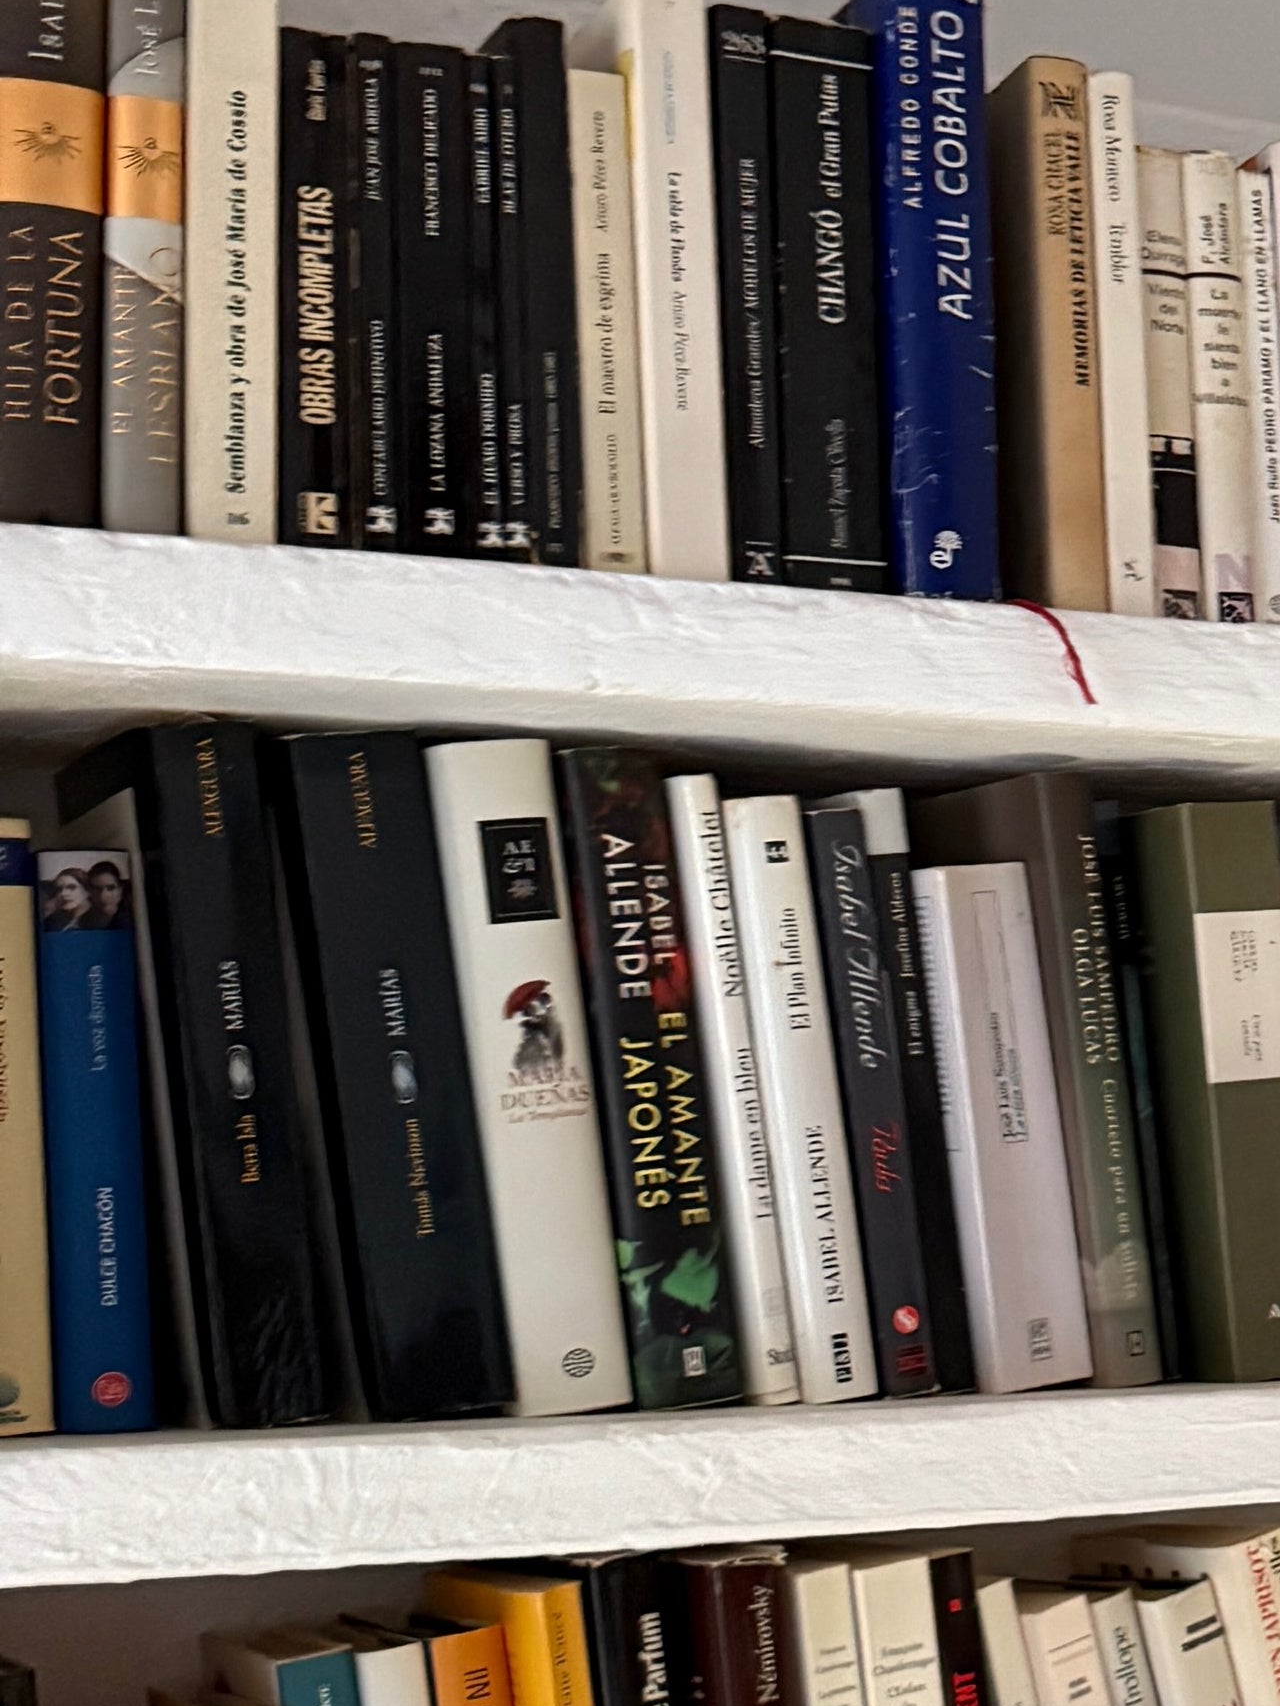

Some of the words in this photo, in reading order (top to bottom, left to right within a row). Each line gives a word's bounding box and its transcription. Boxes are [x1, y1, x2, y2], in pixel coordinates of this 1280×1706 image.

[900, 6, 920, 82] CONDE
[225, 90, 248, 150] Cossío
[819, 75, 839, 126] Putas
[929, 10, 969, 193] COBALTO
[1103, 94, 1120, 131] Rosa
[226, 157, 247, 179] de
[820, 131, 840, 176] Gran
[903, 100, 923, 208] ALFREDO
[1065, 130, 1082, 184] VALLE
[1105, 136, 1125, 202] Montero
[224, 185, 247, 241] María
[823, 182, 842, 198] el
[1047, 195, 1066, 236] ROSA
[1251, 189, 1265, 242] LLAMAS
[7, 224, 35, 262] LA
[1067, 189, 1086, 256] LETICIA
[224, 247, 251, 289] José
[297, 186, 334, 341] INCOMPLETAS
[594, 253, 617, 311] esgrima
[810, 210, 845, 323] CHANGÓ
[936, 213, 973, 318] AZUL
[1069, 260, 1087, 282] DE
[1255, 247, 1268, 265] EN
[5, 284, 33, 321] DE
[226, 295, 248, 318] de
[1256, 269, 1272, 313] LLANO
[43, 231, 84, 425] FORTUNA
[226, 325, 248, 366] obra
[595, 316, 615, 333] de
[1070, 289, 1091, 387] MEMORIAS
[1259, 317, 1272, 332] EL
[3, 343, 34, 421] HIJA
[230, 374, 251, 385] y
[299, 348, 336, 424] OBRAS
[597, 338, 616, 396] maestro
[600, 400, 616, 414] El
[1264, 408, 1279, 452] PEDRO
[224, 392, 247, 492] Semblanza
[196, 738, 225, 836] ALFAGUARA
[349, 751, 377, 848] ALFAGUARA
[699, 809, 731, 912] Châtelet
[601, 834, 649, 998] ALLENDE
[642, 865, 676, 963] ISABEL
[831, 843, 864, 939] Isabel
[713, 918, 743, 998] Noëlle
[777, 908, 804, 966] Infinito
[216, 960, 244, 1029] MARÍAS
[378, 968, 405, 1036] MARÍAS
[785, 971, 807, 1008] Plan
[847, 948, 882, 1068] Allende
[658, 1013, 688, 1047] EL
[789, 1013, 811, 1030] El
[734, 1047, 756, 1093] bleu
[619, 1037, 670, 1208] JAPONÉS
[744, 1099, 759, 1124] en
[664, 1067, 709, 1225] AMANTE
[747, 1130, 769, 1188] dame
[806, 1126, 836, 1222] ALLENDE
[755, 1195, 772, 1219] La
[822, 1228, 844, 1304] ISABEL
[637, 1612, 668, 1700] Parfum
[749, 1584, 781, 1704] Némirovsky
[463, 1666, 492, 1700] Nil
